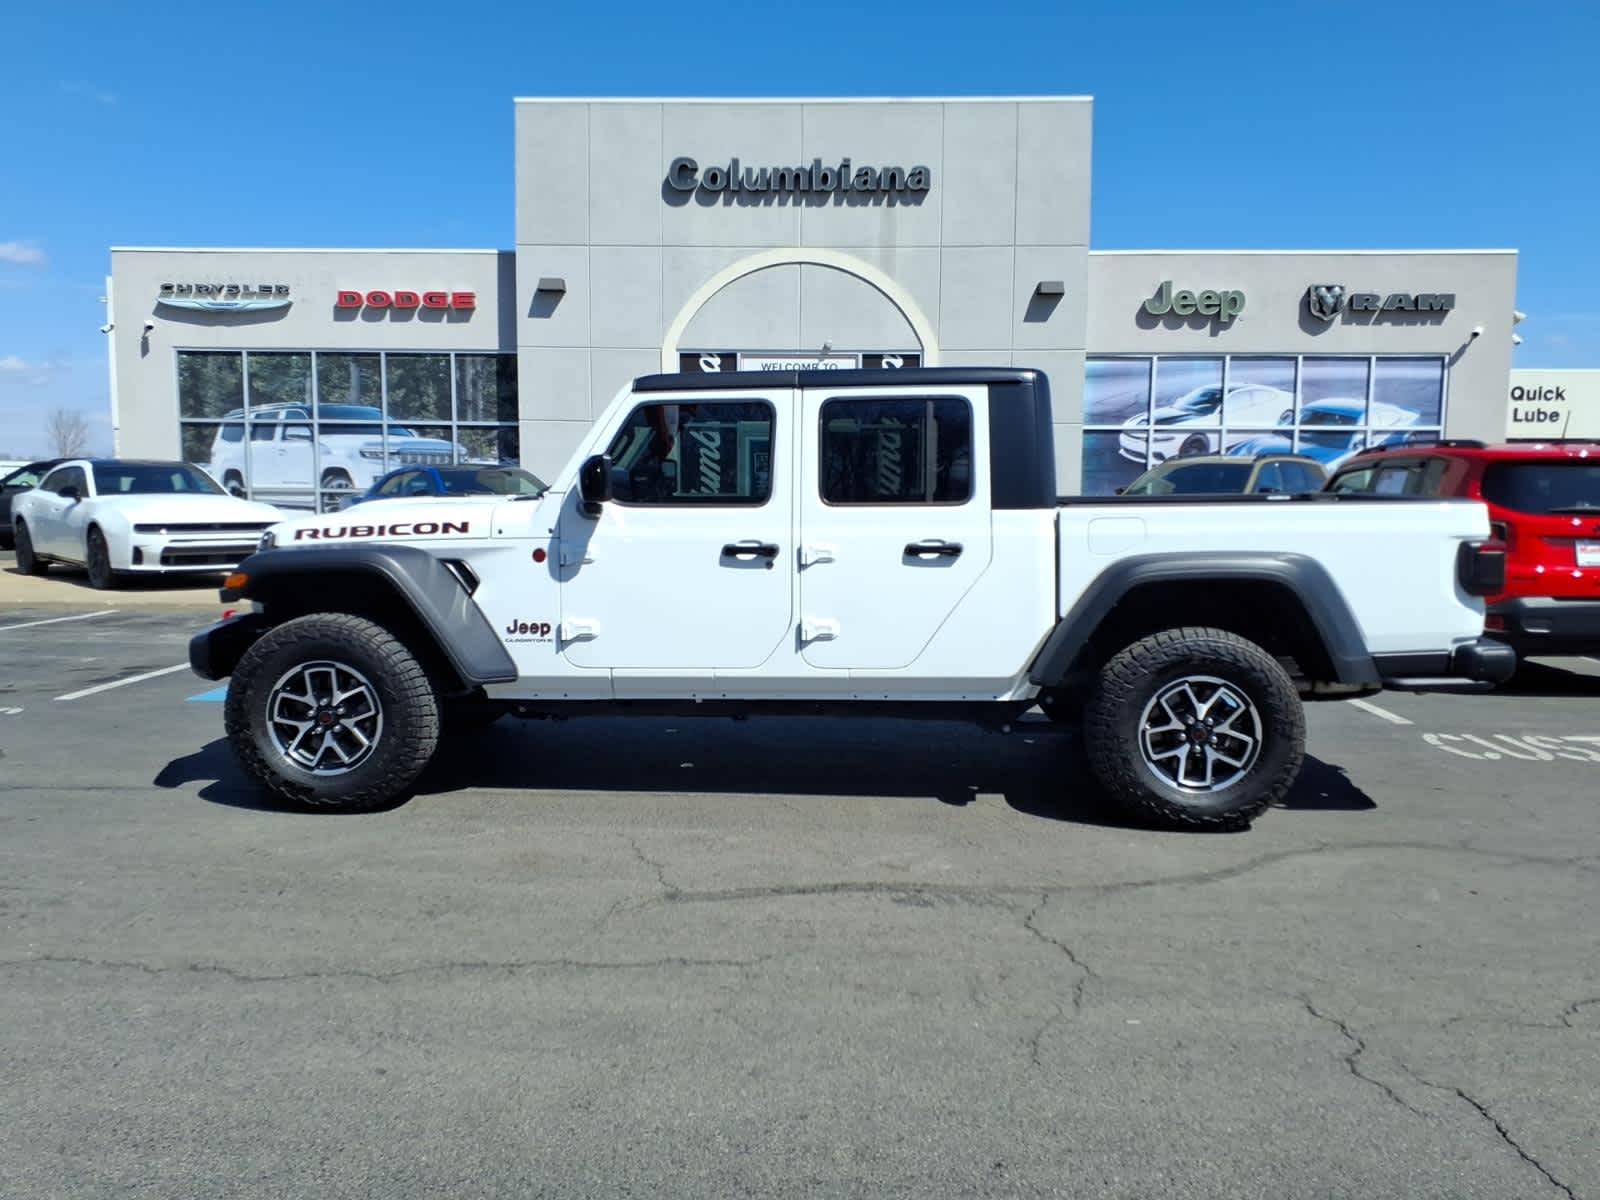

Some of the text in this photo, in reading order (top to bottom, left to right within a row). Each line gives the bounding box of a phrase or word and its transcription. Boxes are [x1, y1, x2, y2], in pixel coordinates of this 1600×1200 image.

[668, 156, 931, 192] Columbiana
[159, 283, 290, 296] CHRYSLER
[337, 290, 476, 309] DODGE
[1144, 280, 1246, 322] Jeep
[1352, 293, 1456, 311] RAM
[1510, 386, 1566, 401] Quick
[1513, 408, 1560, 422] Lube
[294, 521, 470, 541] RUBICON
[506, 619, 551, 637] Jeep
